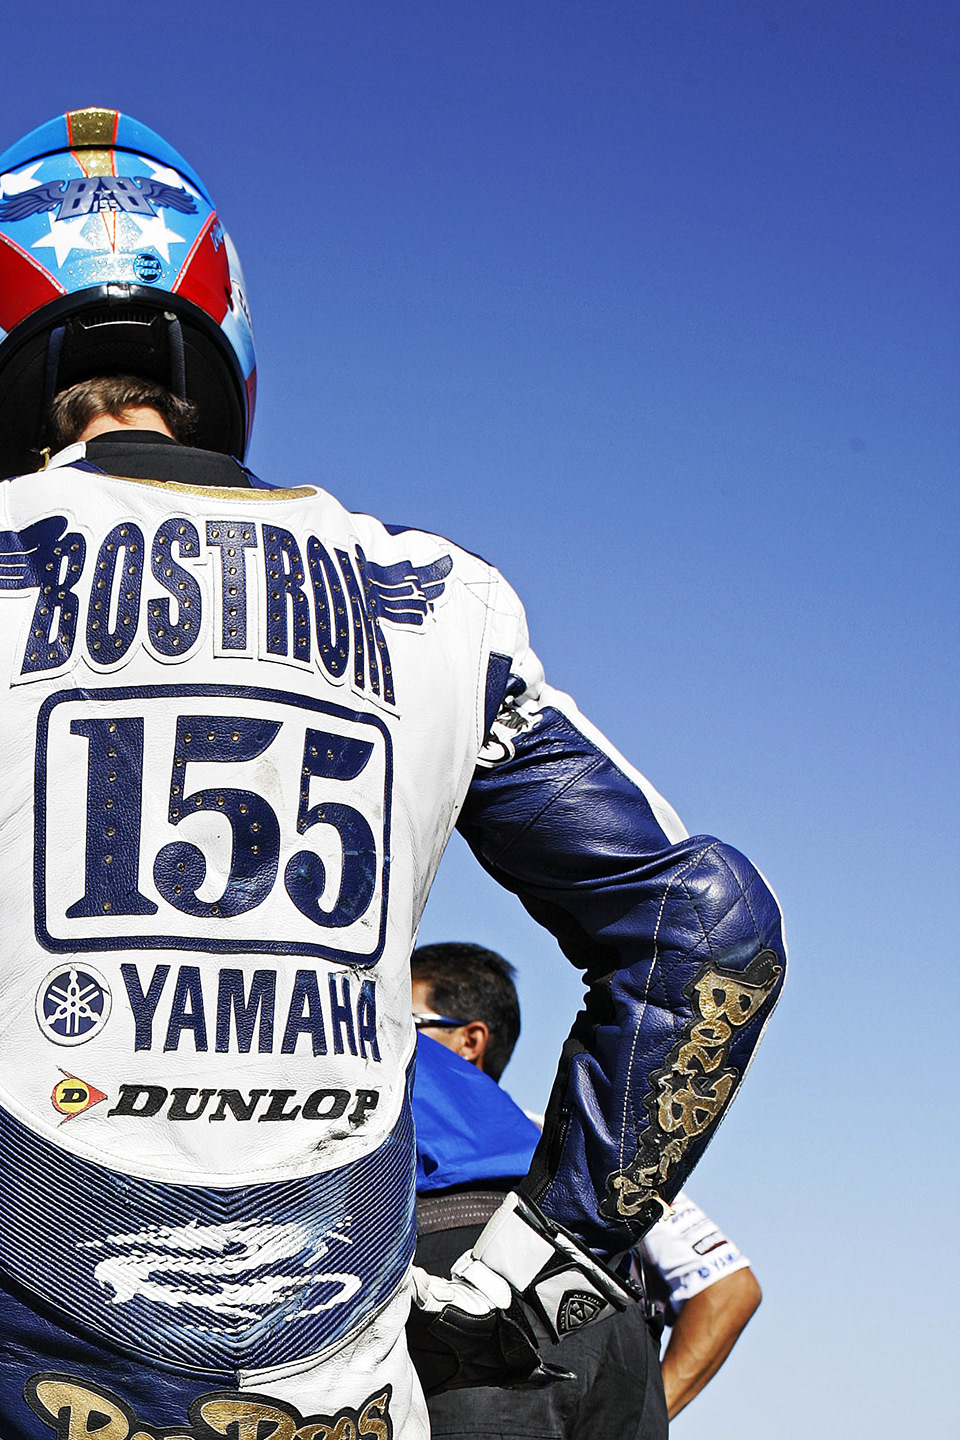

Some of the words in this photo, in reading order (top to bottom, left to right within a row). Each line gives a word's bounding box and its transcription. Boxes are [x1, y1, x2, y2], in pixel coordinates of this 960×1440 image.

[20, 517, 397, 706] BOSTROM
[66, 714, 377, 929] 155
[120, 962, 382, 1063] YAMAHA
[107, 1084, 381, 1127] DUNLOP
